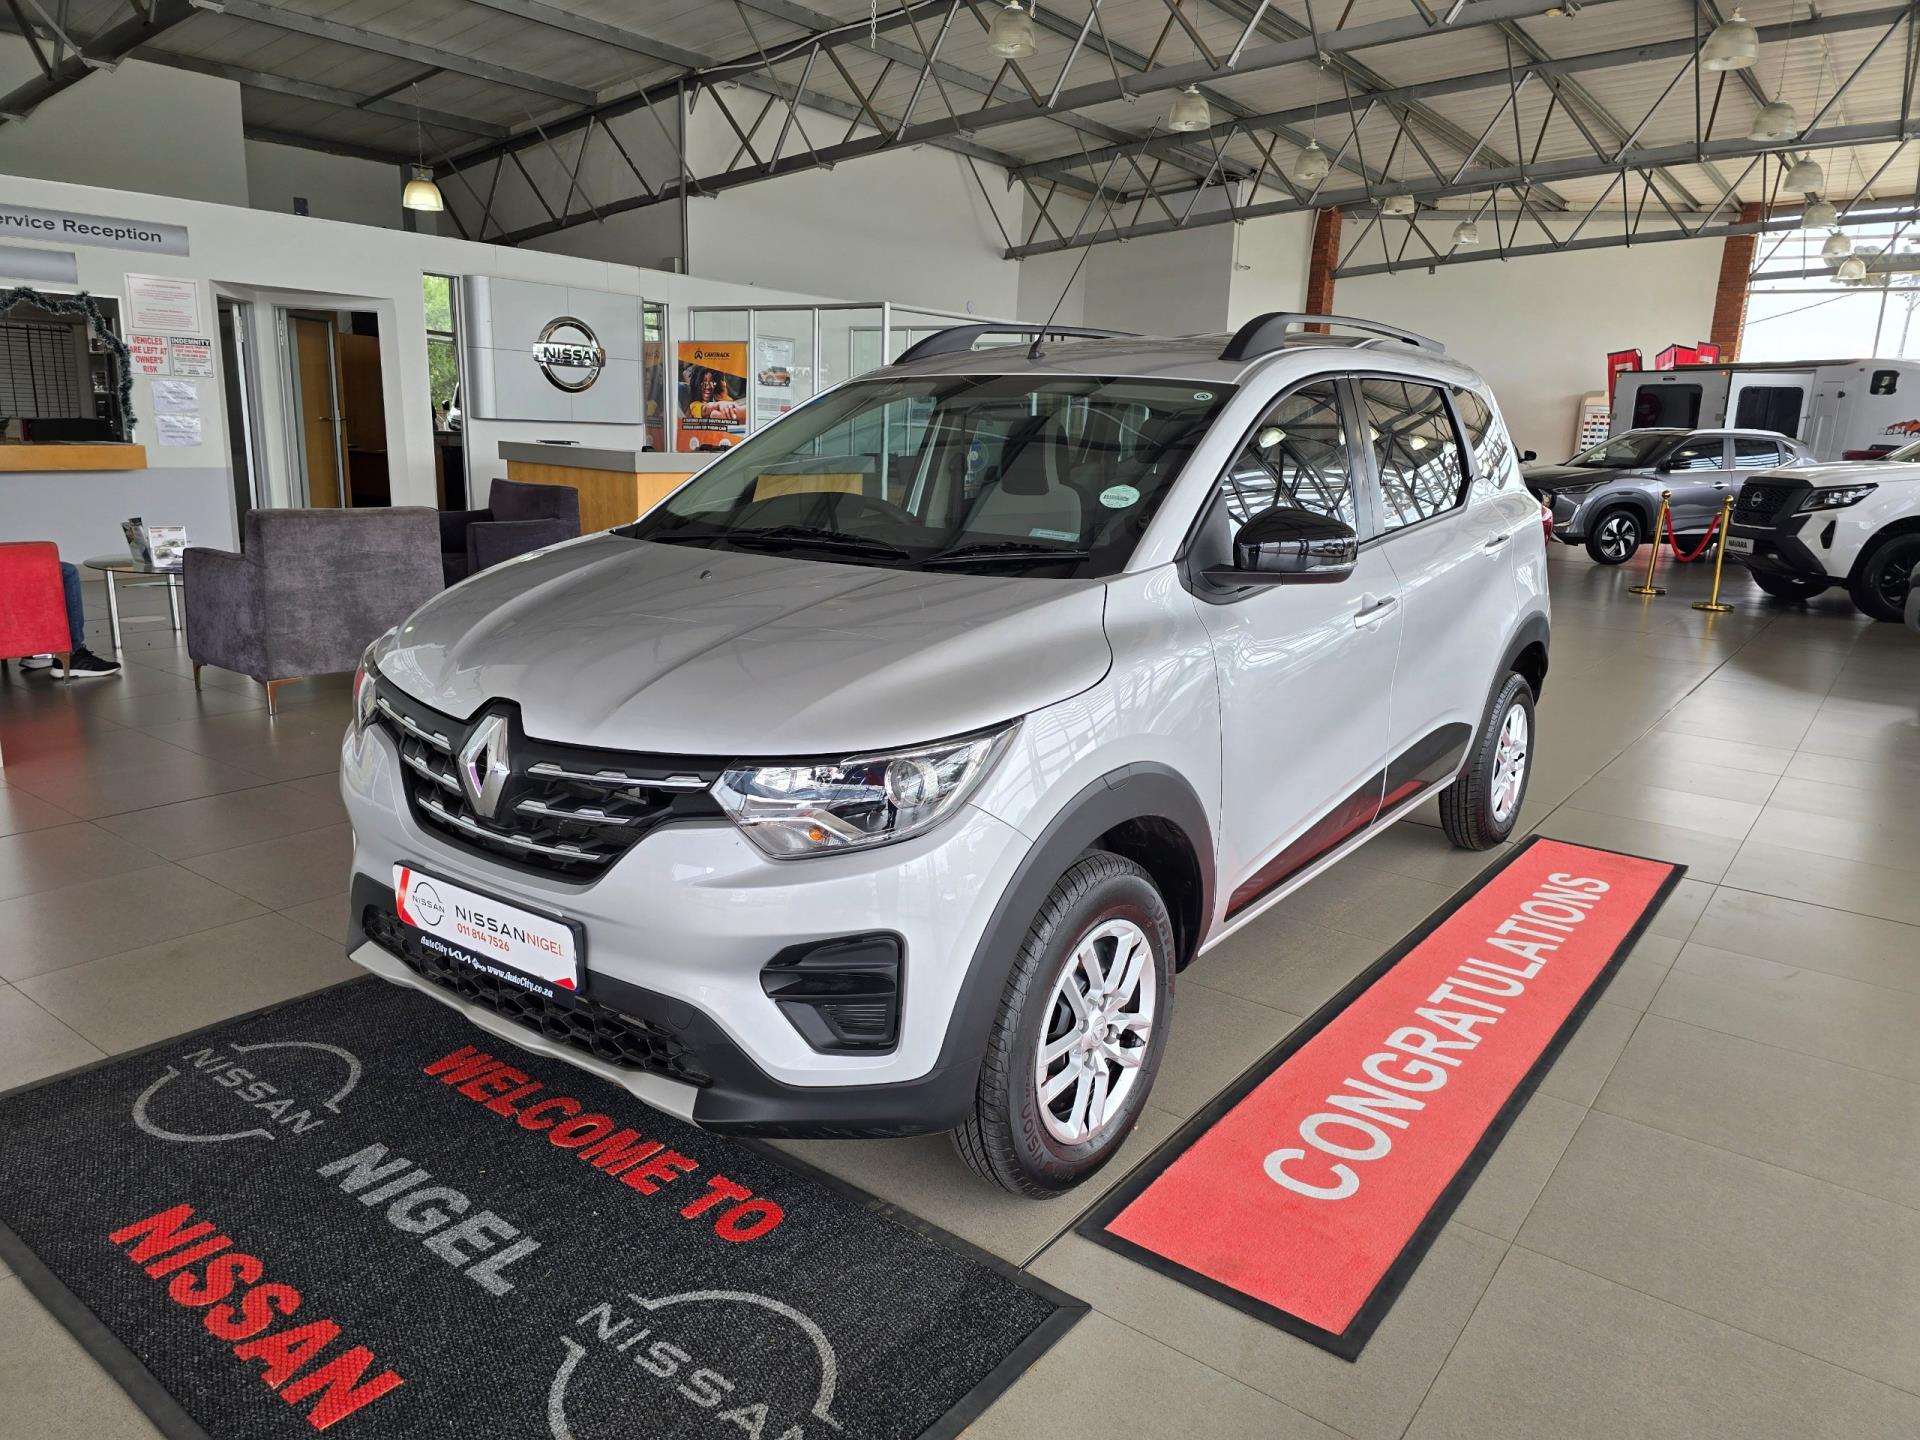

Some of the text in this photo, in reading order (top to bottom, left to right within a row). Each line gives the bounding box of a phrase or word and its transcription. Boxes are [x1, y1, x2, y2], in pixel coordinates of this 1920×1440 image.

[62, 219, 162, 243] Reception
[132, 336, 163, 345] VEHICLES
[144, 347, 158, 355] LEFT
[160, 348, 168, 356] AT
[543, 346, 601, 366] NISSAN
[143, 365, 159, 374] RISK
[412, 894, 446, 914] NISSAN
[420, 935, 448, 957] AutoCity
[457, 923, 510, 952] 011 814 7526
[1263, 872, 1611, 1200] CONGRATULATIONS
[183, 1047, 327, 1134] NISSAN
[423, 1045, 785, 1242] WELCOME TO
[316, 1141, 542, 1296] NIGEL
[108, 1202, 404, 1431] NISSAN
[576, 1301, 804, 1440] NISSA
